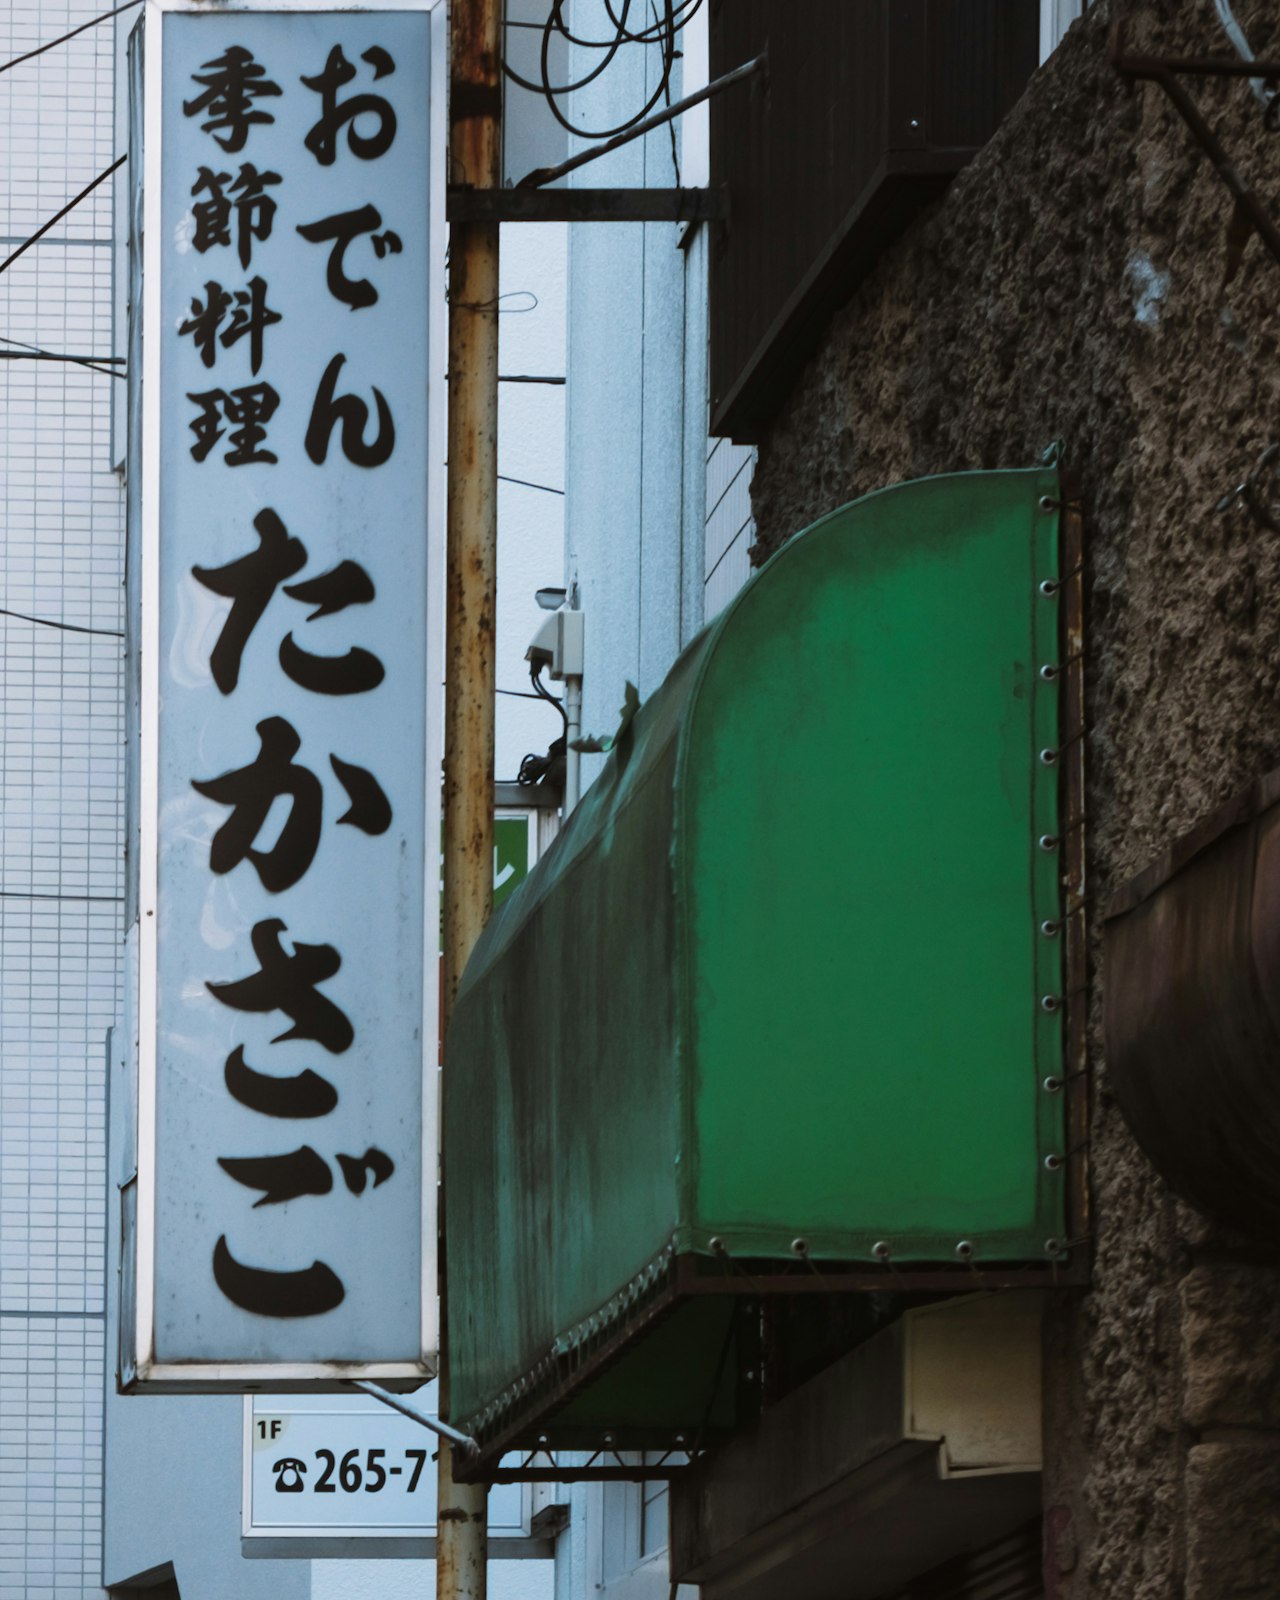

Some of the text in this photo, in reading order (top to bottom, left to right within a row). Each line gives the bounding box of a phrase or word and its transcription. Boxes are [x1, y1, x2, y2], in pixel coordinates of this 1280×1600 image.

[178, 45, 283, 467] 季節料理
[296, 44, 402, 468] おでん
[190, 507, 394, 1318] たかさご
[257, 1420, 282, 1440] 1F
[314, 1449, 439, 1493] 265-7
